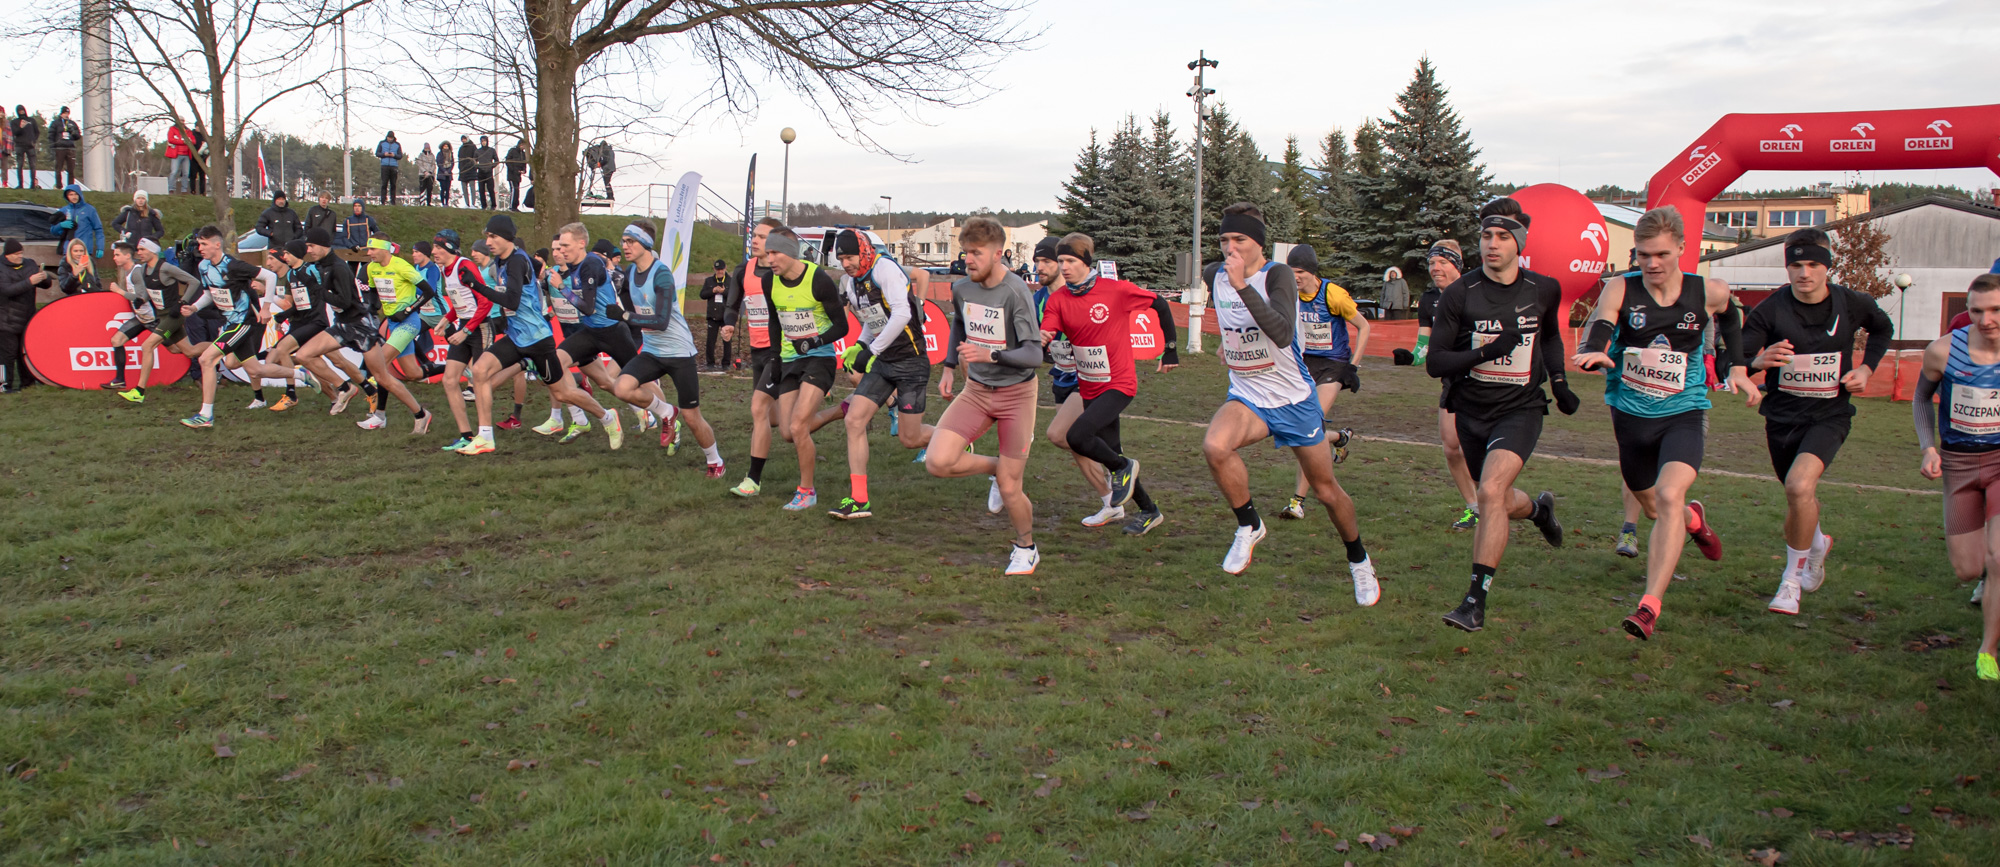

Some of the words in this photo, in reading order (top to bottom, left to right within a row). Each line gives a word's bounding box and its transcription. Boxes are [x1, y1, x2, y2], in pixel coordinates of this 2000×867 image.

[1762, 142, 1800, 151] ORLEN
[1832, 141, 1872, 150] ORLEN
[1907, 139, 1950, 149] ORLEN
[1685, 154, 1718, 182] ORLEN
[794, 312, 810, 320] 314
[984, 308, 1000, 319] 272
[1299, 311, 1320, 323] STRA
[969, 321, 995, 335] SMYK
[1240, 333, 1260, 344] 107
[1088, 348, 1103, 356] 169
[1225, 348, 1269, 361] POGORZELSKI
[1493, 355, 1513, 366] LIS
[1659, 353, 1683, 365] 338
[1813, 355, 1837, 366] 525
[1077, 360, 1106, 370] NOWAK
[1626, 362, 1682, 384] MARSZK
[1783, 371, 1837, 383] OCHNIK
